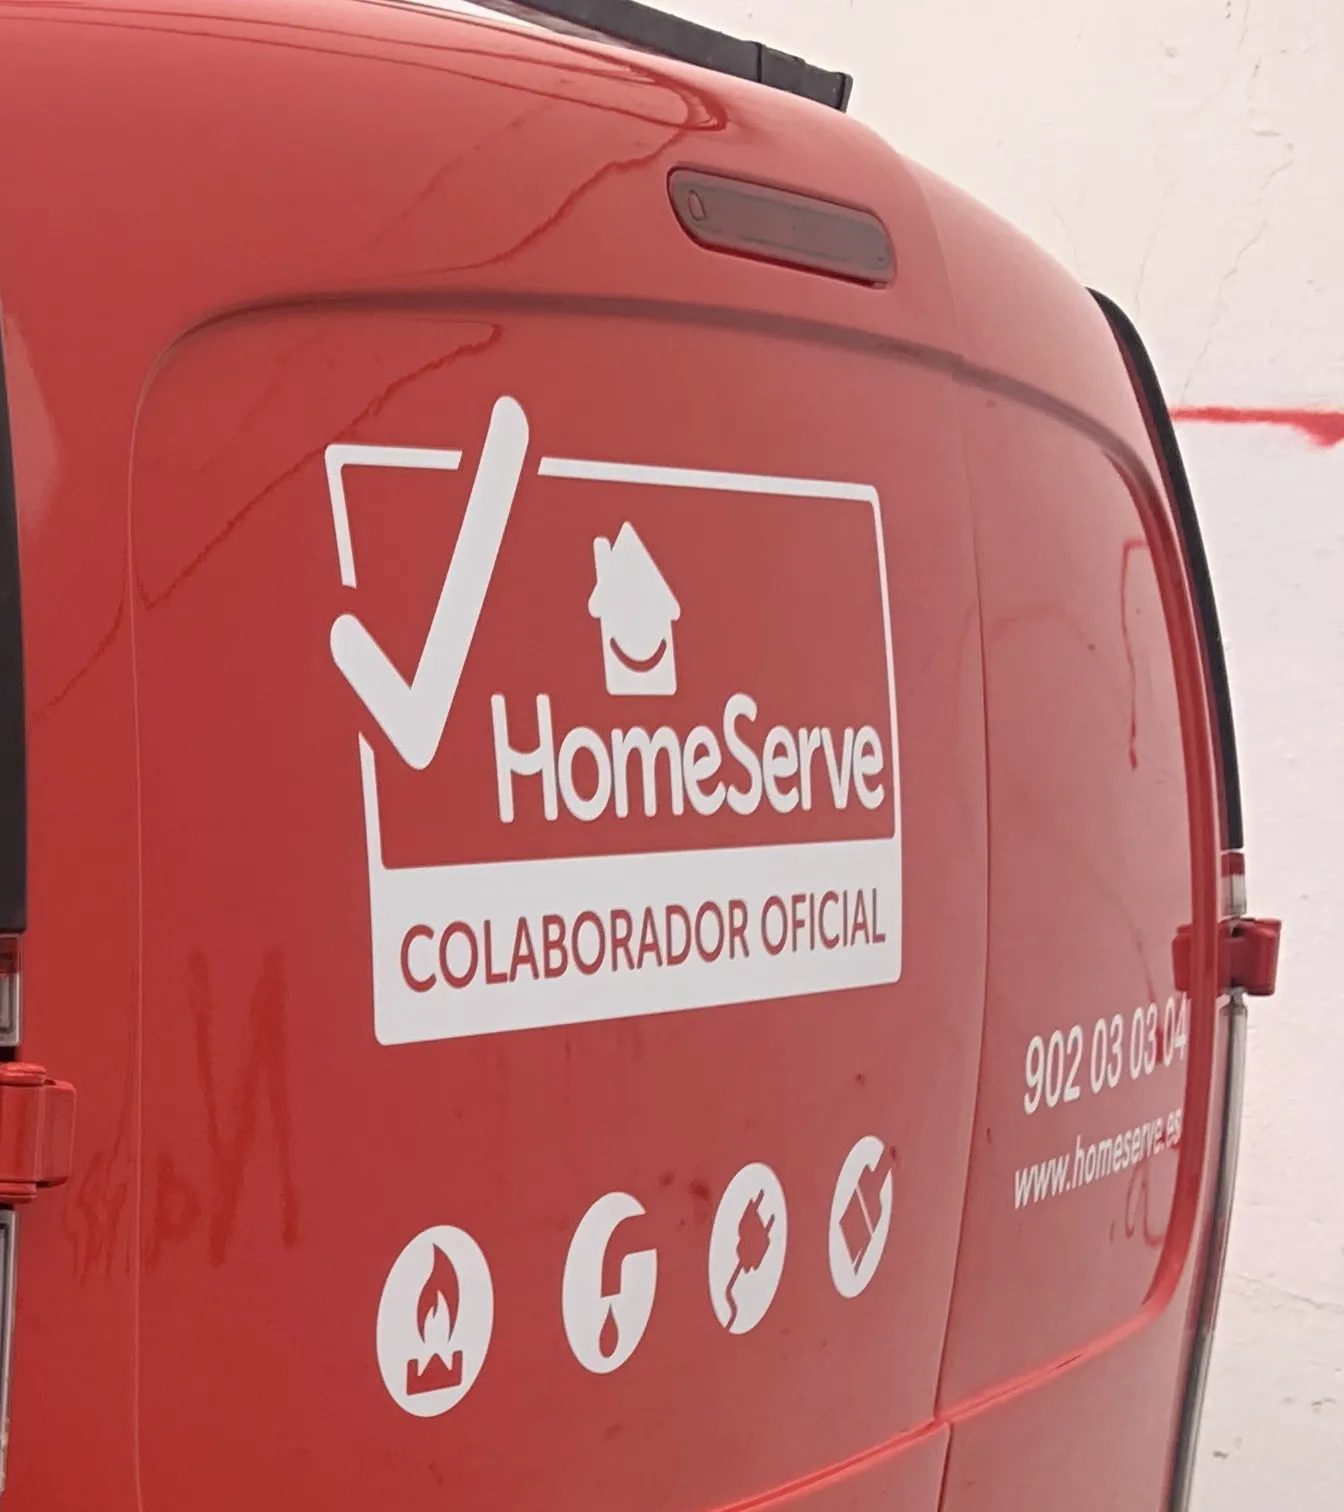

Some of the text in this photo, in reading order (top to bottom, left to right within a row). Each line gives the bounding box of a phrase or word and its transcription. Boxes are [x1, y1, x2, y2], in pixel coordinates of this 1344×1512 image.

[490, 692, 884, 822] HomeServe
[400, 887, 886, 992] COLABORADOR OFICIAL
[1023, 992, 1188, 1115] 902 03 03 04
[1014, 1107, 1183, 1210] www.homeserve.es
